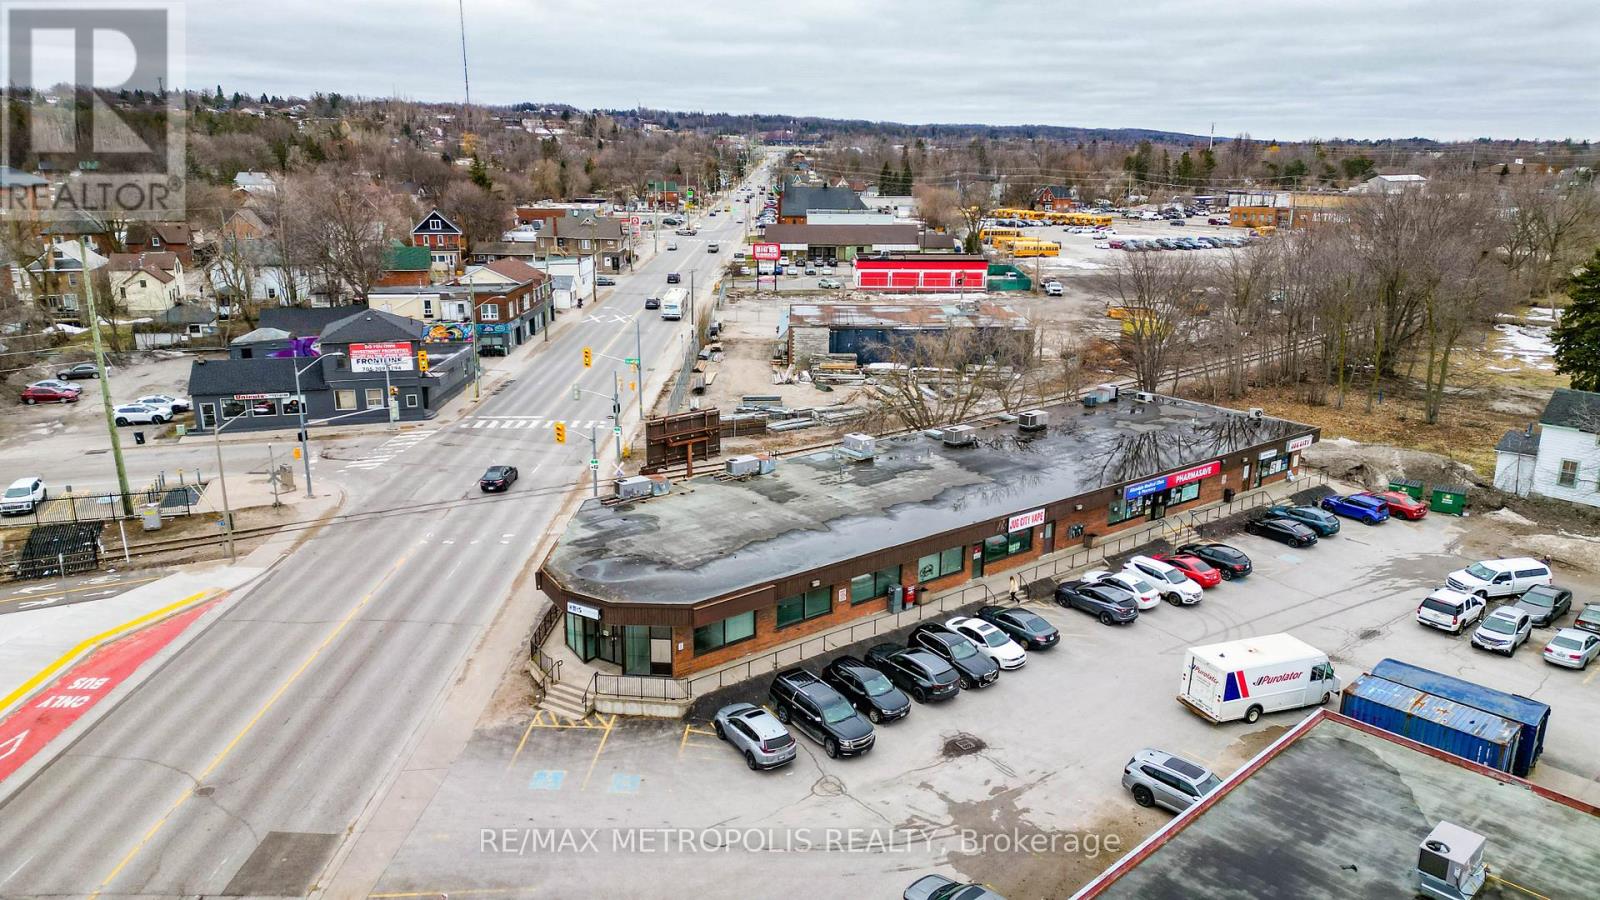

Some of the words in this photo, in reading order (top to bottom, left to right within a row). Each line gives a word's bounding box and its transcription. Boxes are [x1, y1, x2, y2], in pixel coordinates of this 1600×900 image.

[1175, 466, 1212, 483] PHARMASAVE
[1010, 519, 1019, 529] JUG
[1020, 515, 1031, 526] CITY
[1032, 511, 1044, 522] VAPE
[1195, 665, 1219, 684] Purolator
[1262, 671, 1303, 685] Purolator
[67, 677, 111, 690] BUS
[35, 695, 91, 708] ONLY
